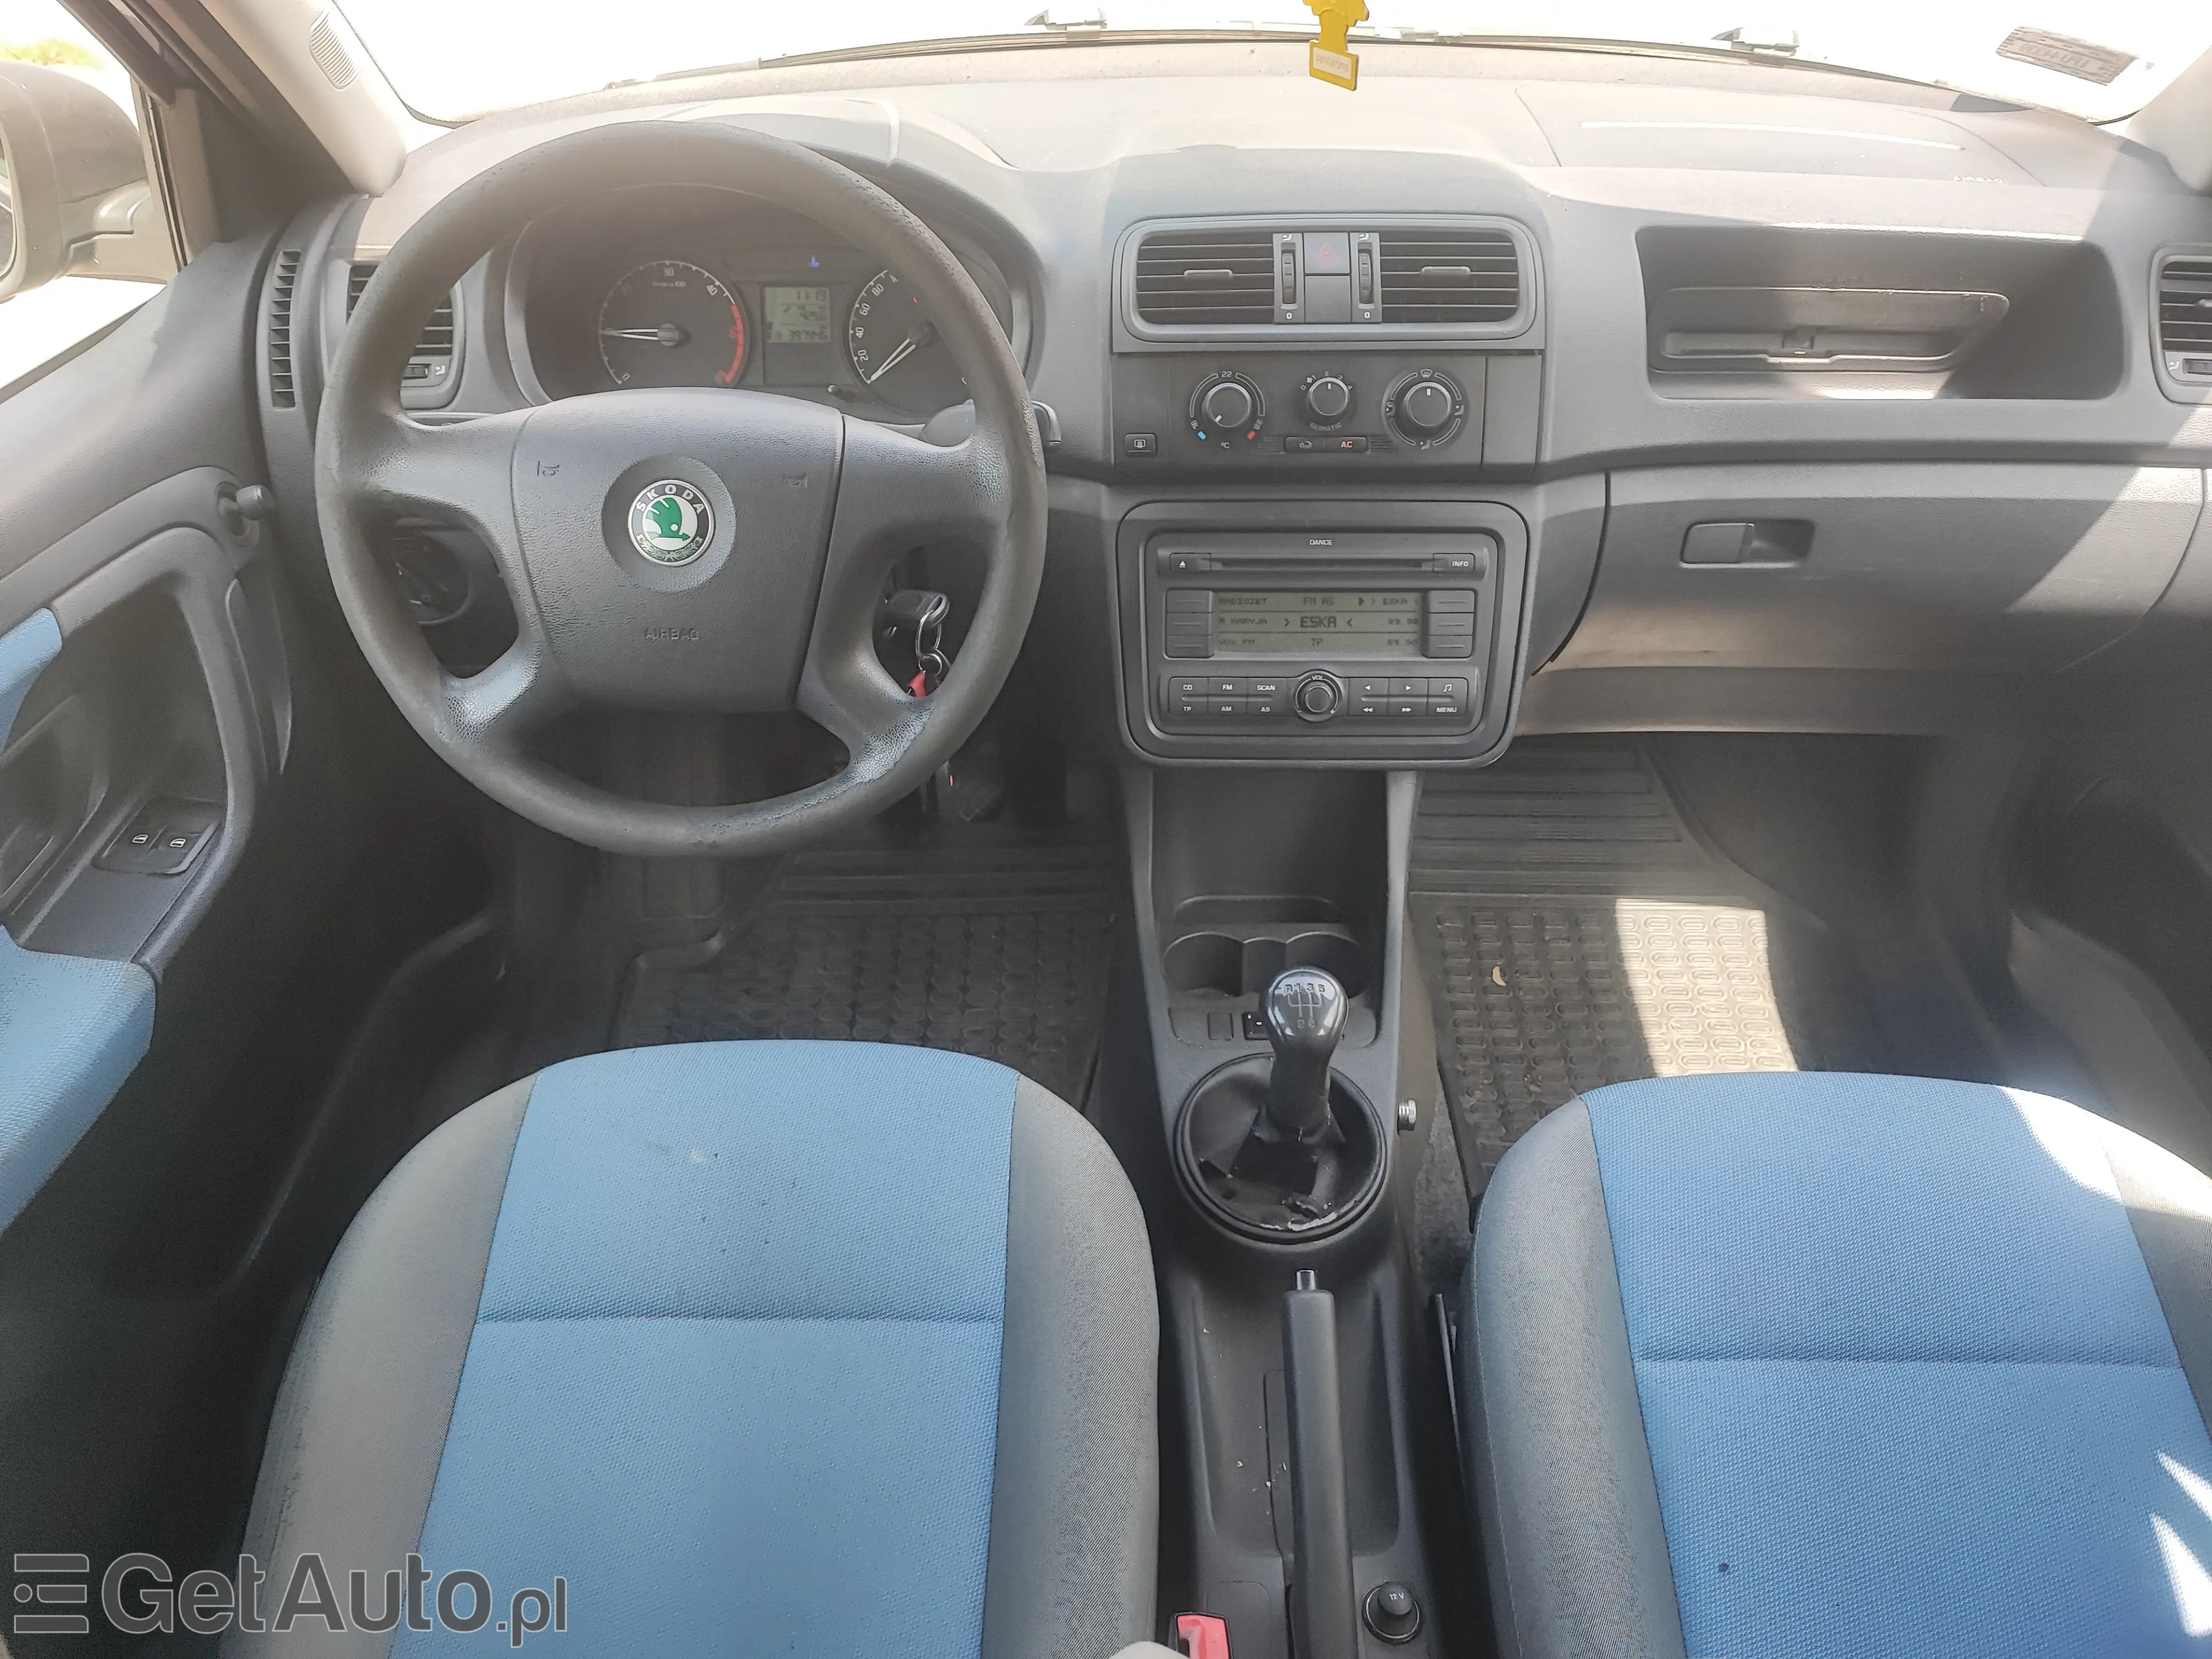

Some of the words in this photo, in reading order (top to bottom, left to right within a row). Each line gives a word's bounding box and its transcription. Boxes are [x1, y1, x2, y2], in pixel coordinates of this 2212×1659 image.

[706, 285, 718, 296] 40
[872, 283, 884, 296] 80
[859, 303, 870, 316] 60
[855, 327, 864, 338] 40
[858, 349, 869, 362] 20
[1190, 420, 1199, 430] 16
[1253, 419, 1263, 430] 28
[1310, 422, 1342, 432] CLIMATIC
[1303, 597, 1317, 605] FM
[1321, 597, 1335, 606] AS
[1300, 615, 1337, 628] ESKA
[644, 627, 700, 641] AIRBAG
[1310, 638, 1324, 647] TP
